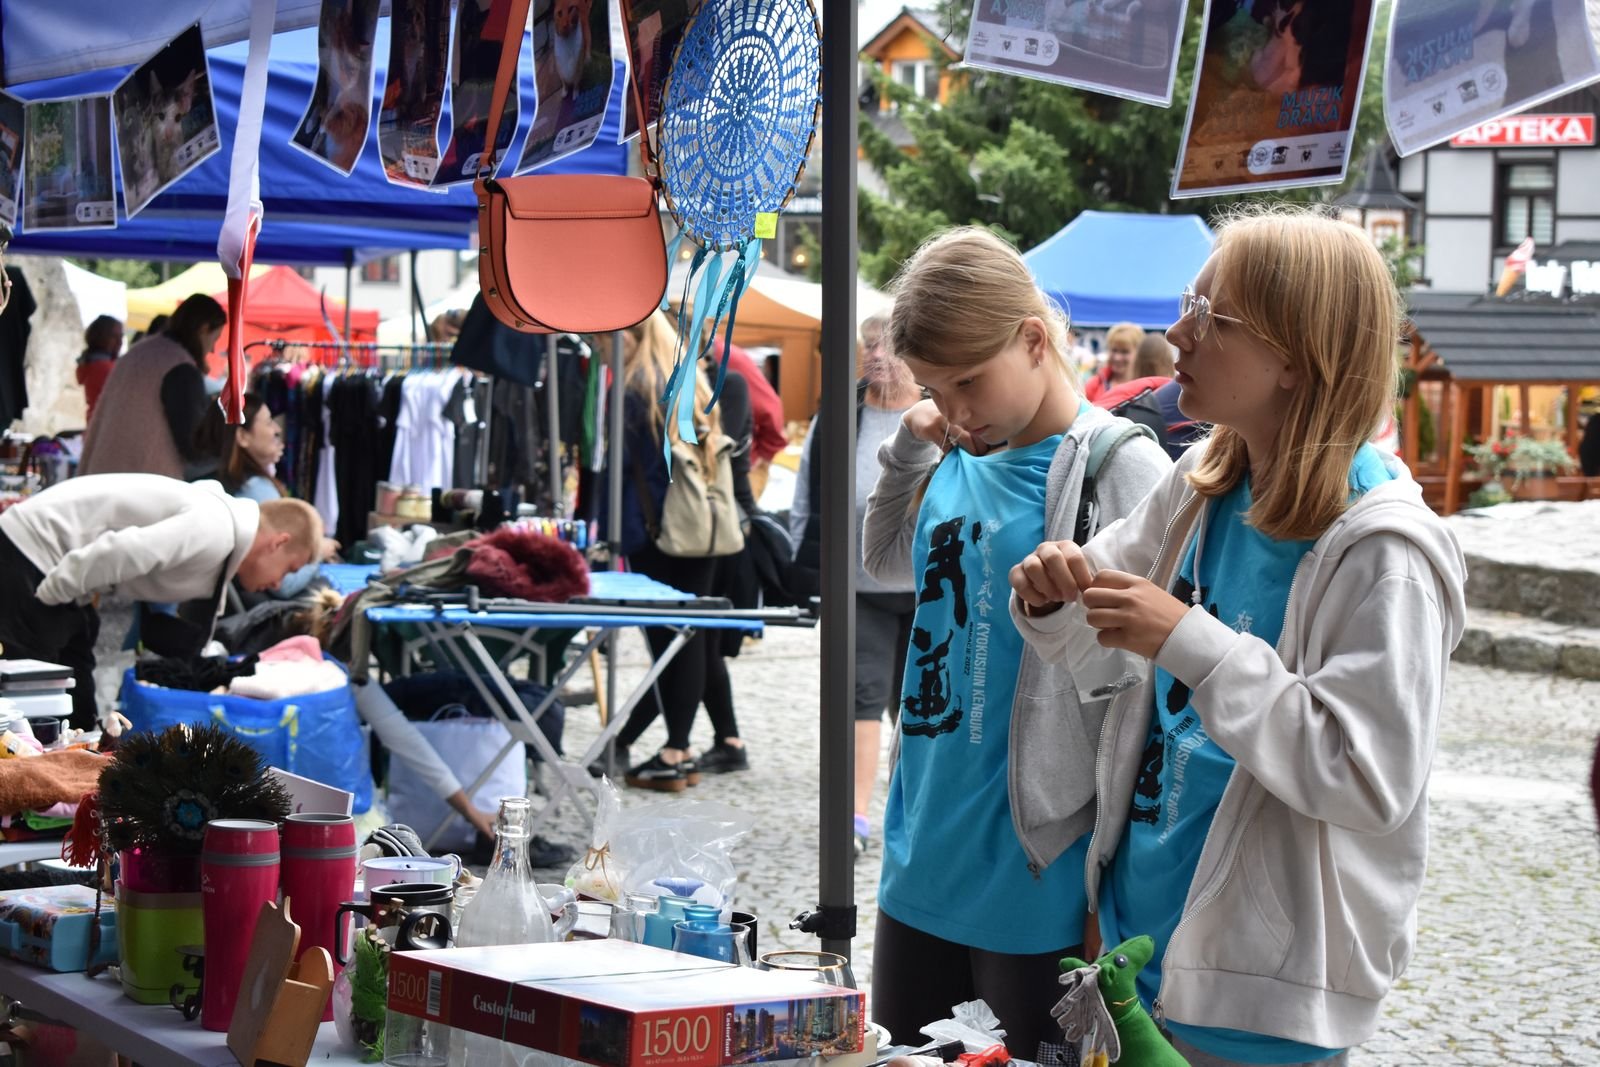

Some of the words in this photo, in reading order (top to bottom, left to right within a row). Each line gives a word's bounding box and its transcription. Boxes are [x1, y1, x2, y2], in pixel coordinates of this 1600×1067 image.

[1281, 86, 1343, 112] MJUZIK
[1277, 104, 1339, 129] DRAKA
[1457, 117, 1588, 143] APTEKA
[963, 656, 971, 677] 2022
[972, 622, 991, 687] KYOKUSHIN
[969, 688, 986, 745] KENBUKAI
[1166, 715, 1195, 744] WAKACJE
[392, 970, 427, 1002] 1500
[640, 1014, 711, 1057] 1500
[724, 1012, 732, 1057] Castorland
